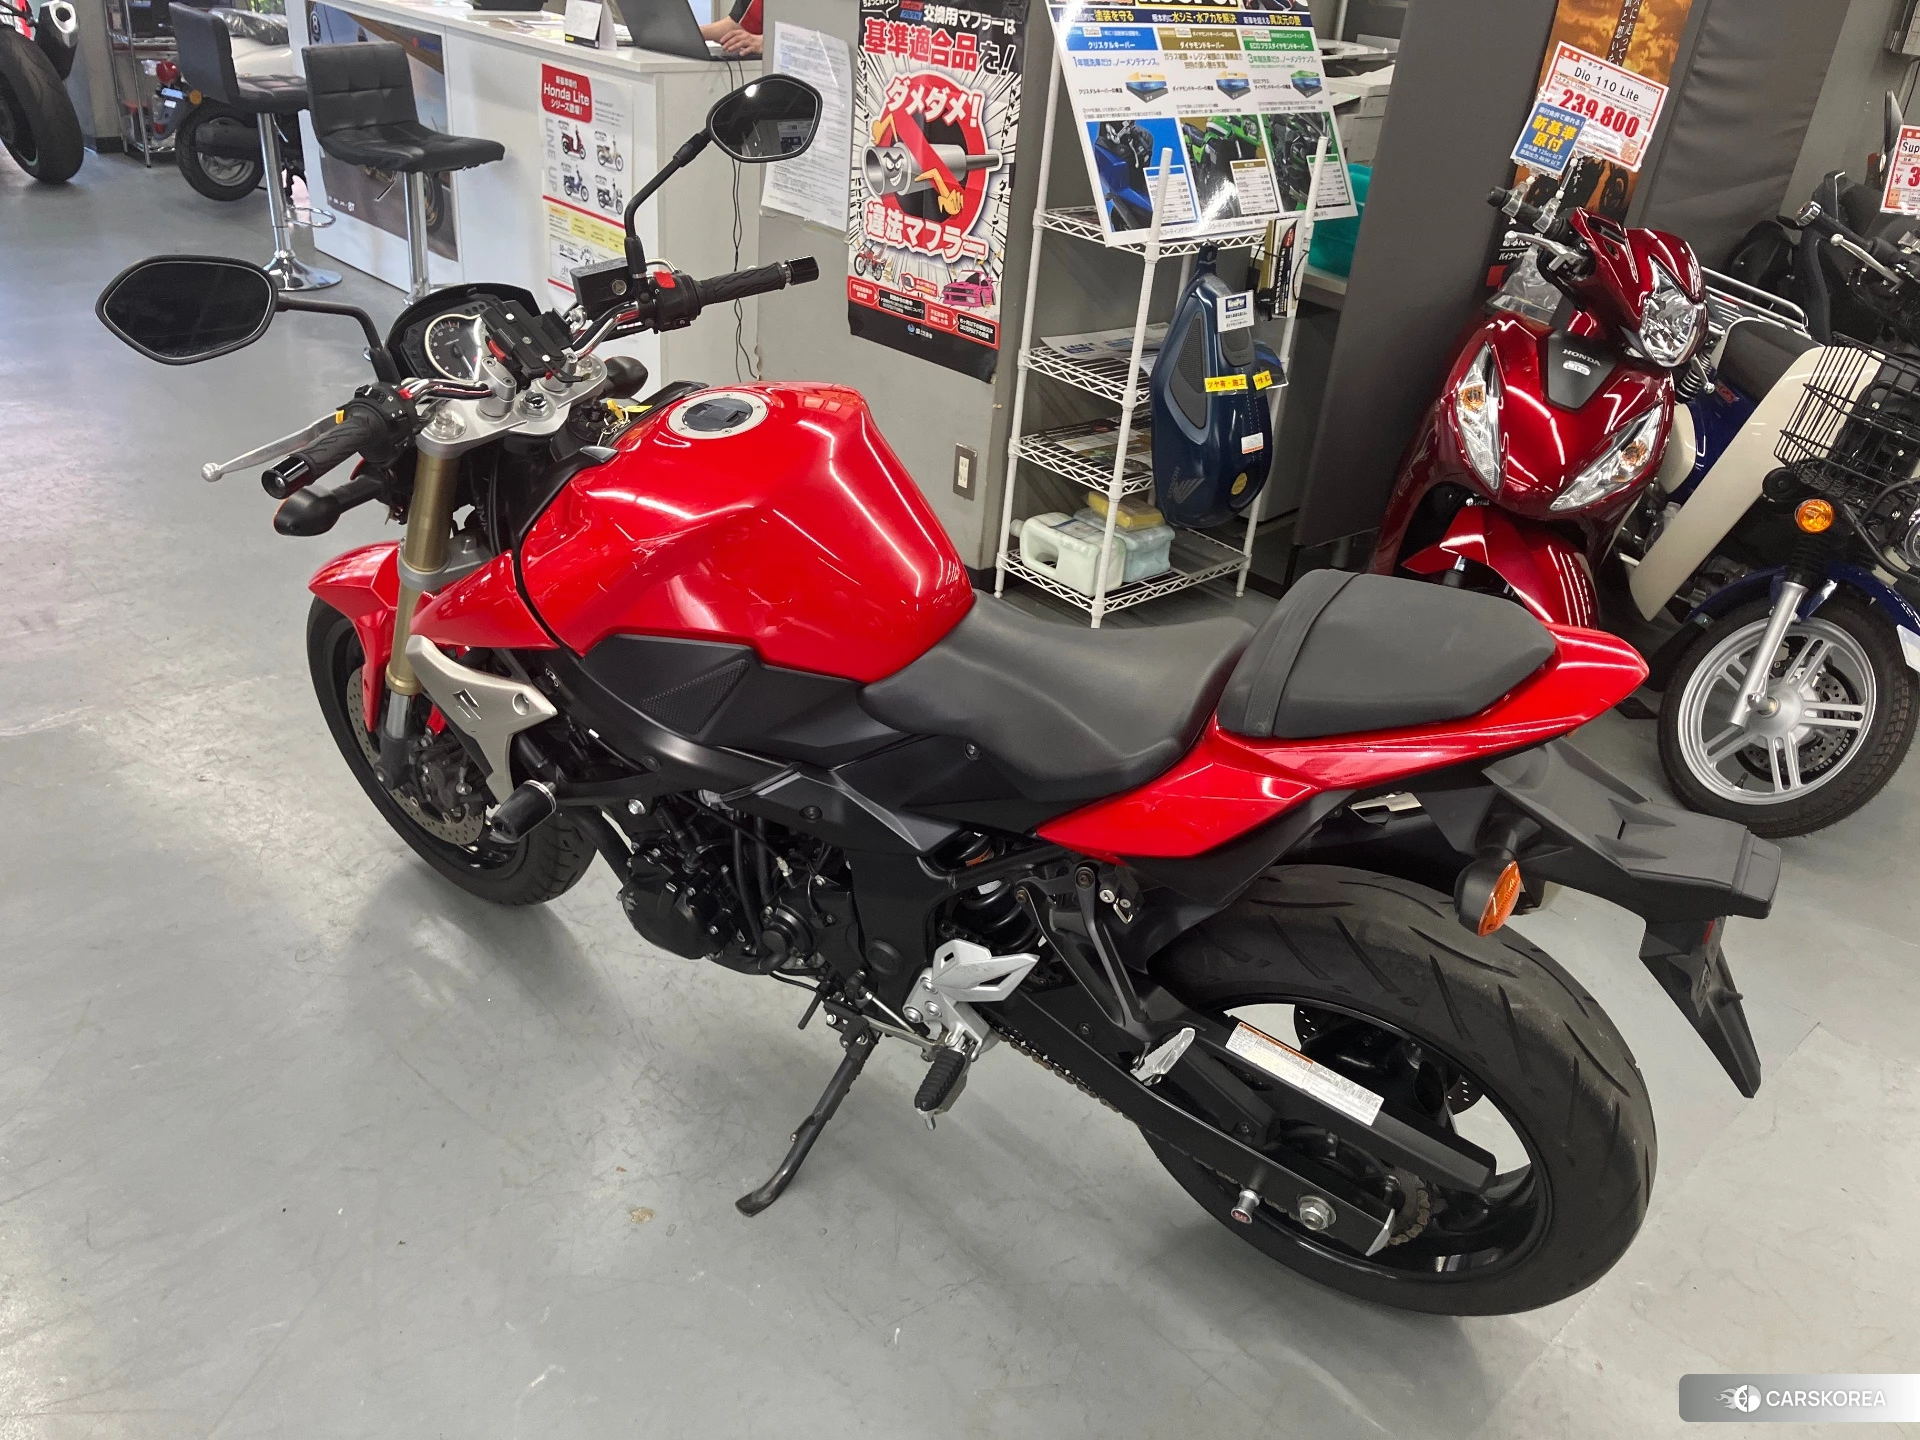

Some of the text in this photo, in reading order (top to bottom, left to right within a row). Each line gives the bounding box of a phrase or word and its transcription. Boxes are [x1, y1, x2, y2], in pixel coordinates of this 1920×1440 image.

[923, 4, 1016, 35] 交換用マフラーは
[1087, 41, 1136, 50] クリスタルキーパー
[1179, 41, 1225, 50] ダイヤモンドキーパー
[543, 81, 590, 106] Honda Lite
[1574, 66, 1592, 82] Dio
[1596, 76, 1618, 93] 110
[1619, 85, 1640, 102] Lite
[1532, 114, 1578, 141] 新基準
[1532, 131, 1564, 153] 原付
[1562, 348, 1602, 367] HONDA
